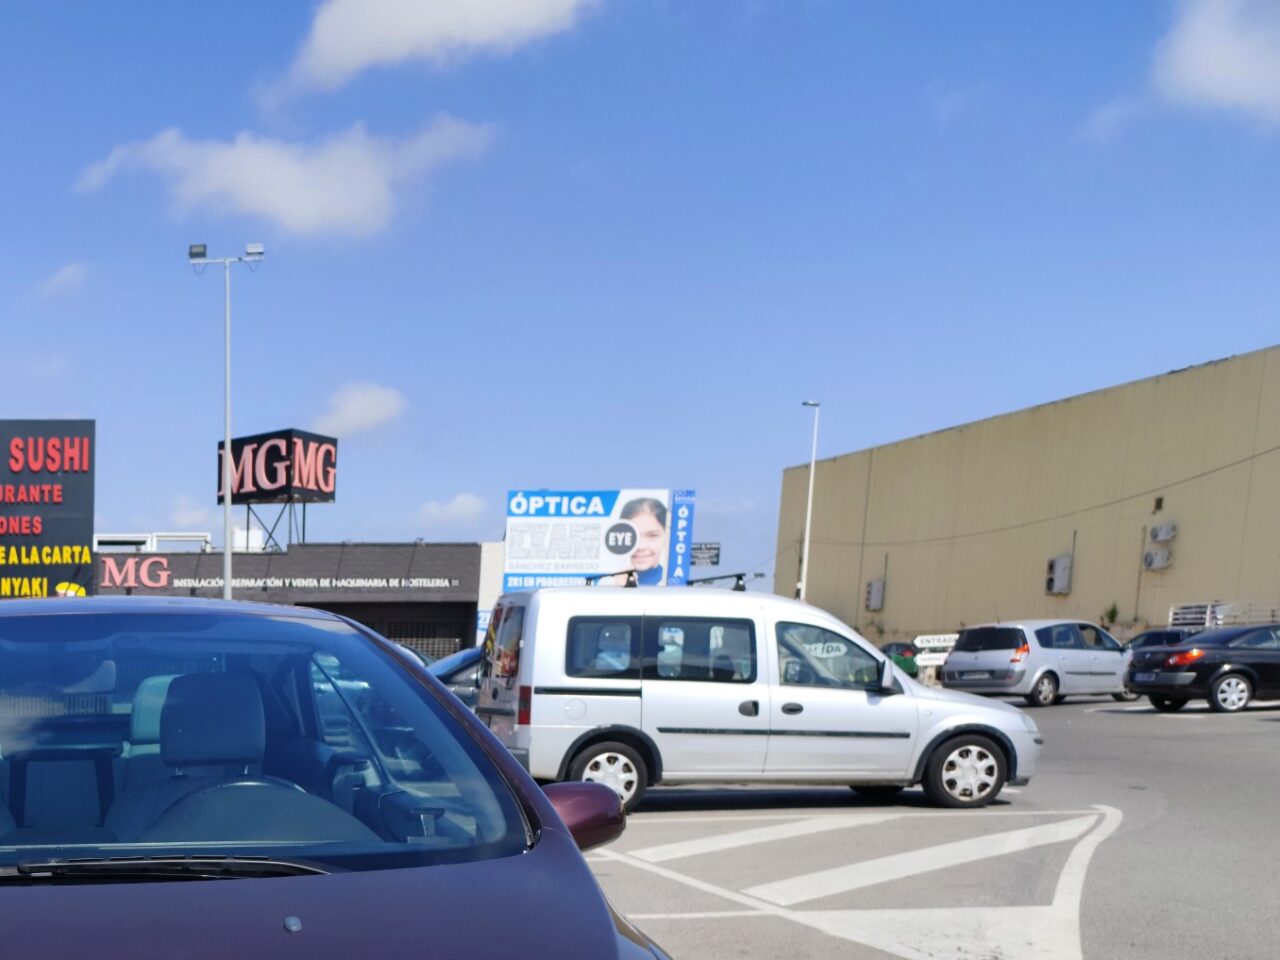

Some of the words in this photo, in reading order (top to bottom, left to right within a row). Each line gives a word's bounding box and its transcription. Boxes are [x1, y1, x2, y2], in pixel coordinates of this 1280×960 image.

[9, 437, 89, 472] SUSHI
[218, 438, 290, 496] MG
[292, 437, 336, 492] MG
[510, 492, 605, 514] ÓPTICA
[608, 532, 632, 546] EYE
[8, 546, 19, 565] A
[21, 546, 40, 564] LA
[42, 546, 92, 564] CARTA
[101, 556, 172, 588] MG
[291, 578, 318, 587] VENTA
[320, 578, 330, 587] DE
[389, 578, 399, 587] DE
